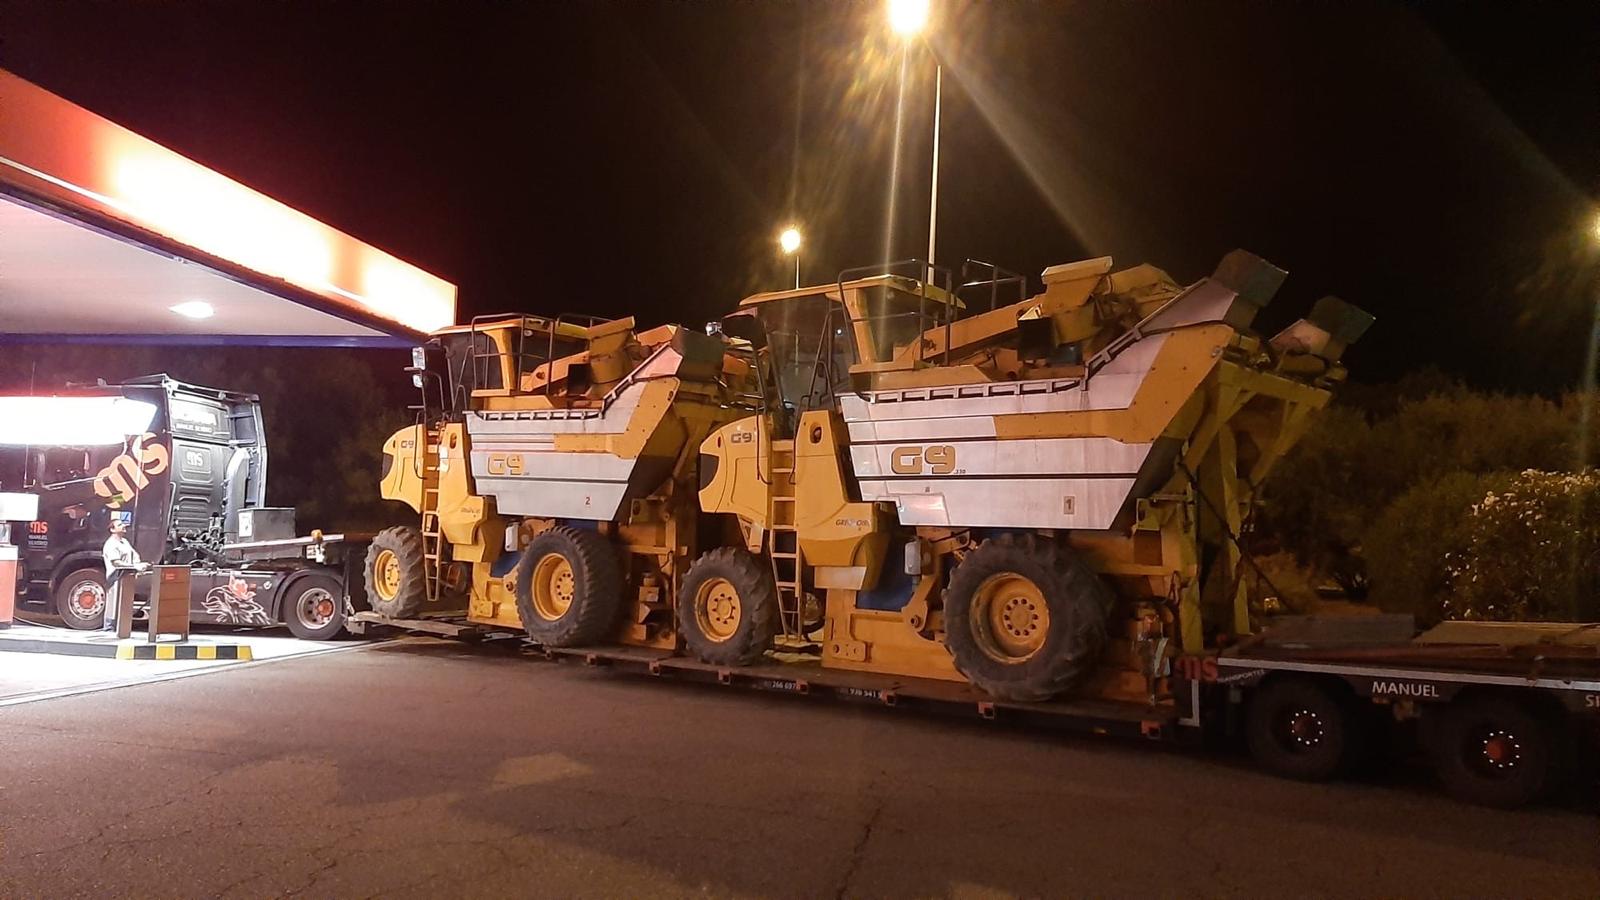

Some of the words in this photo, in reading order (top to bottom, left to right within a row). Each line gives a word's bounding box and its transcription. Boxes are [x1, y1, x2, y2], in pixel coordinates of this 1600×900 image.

[731, 432, 752, 443] G9
[488, 453, 525, 476] G9
[891, 446, 956, 475] G9
[585, 497, 591, 506] 2
[1371, 681, 1440, 698] MANUEL
